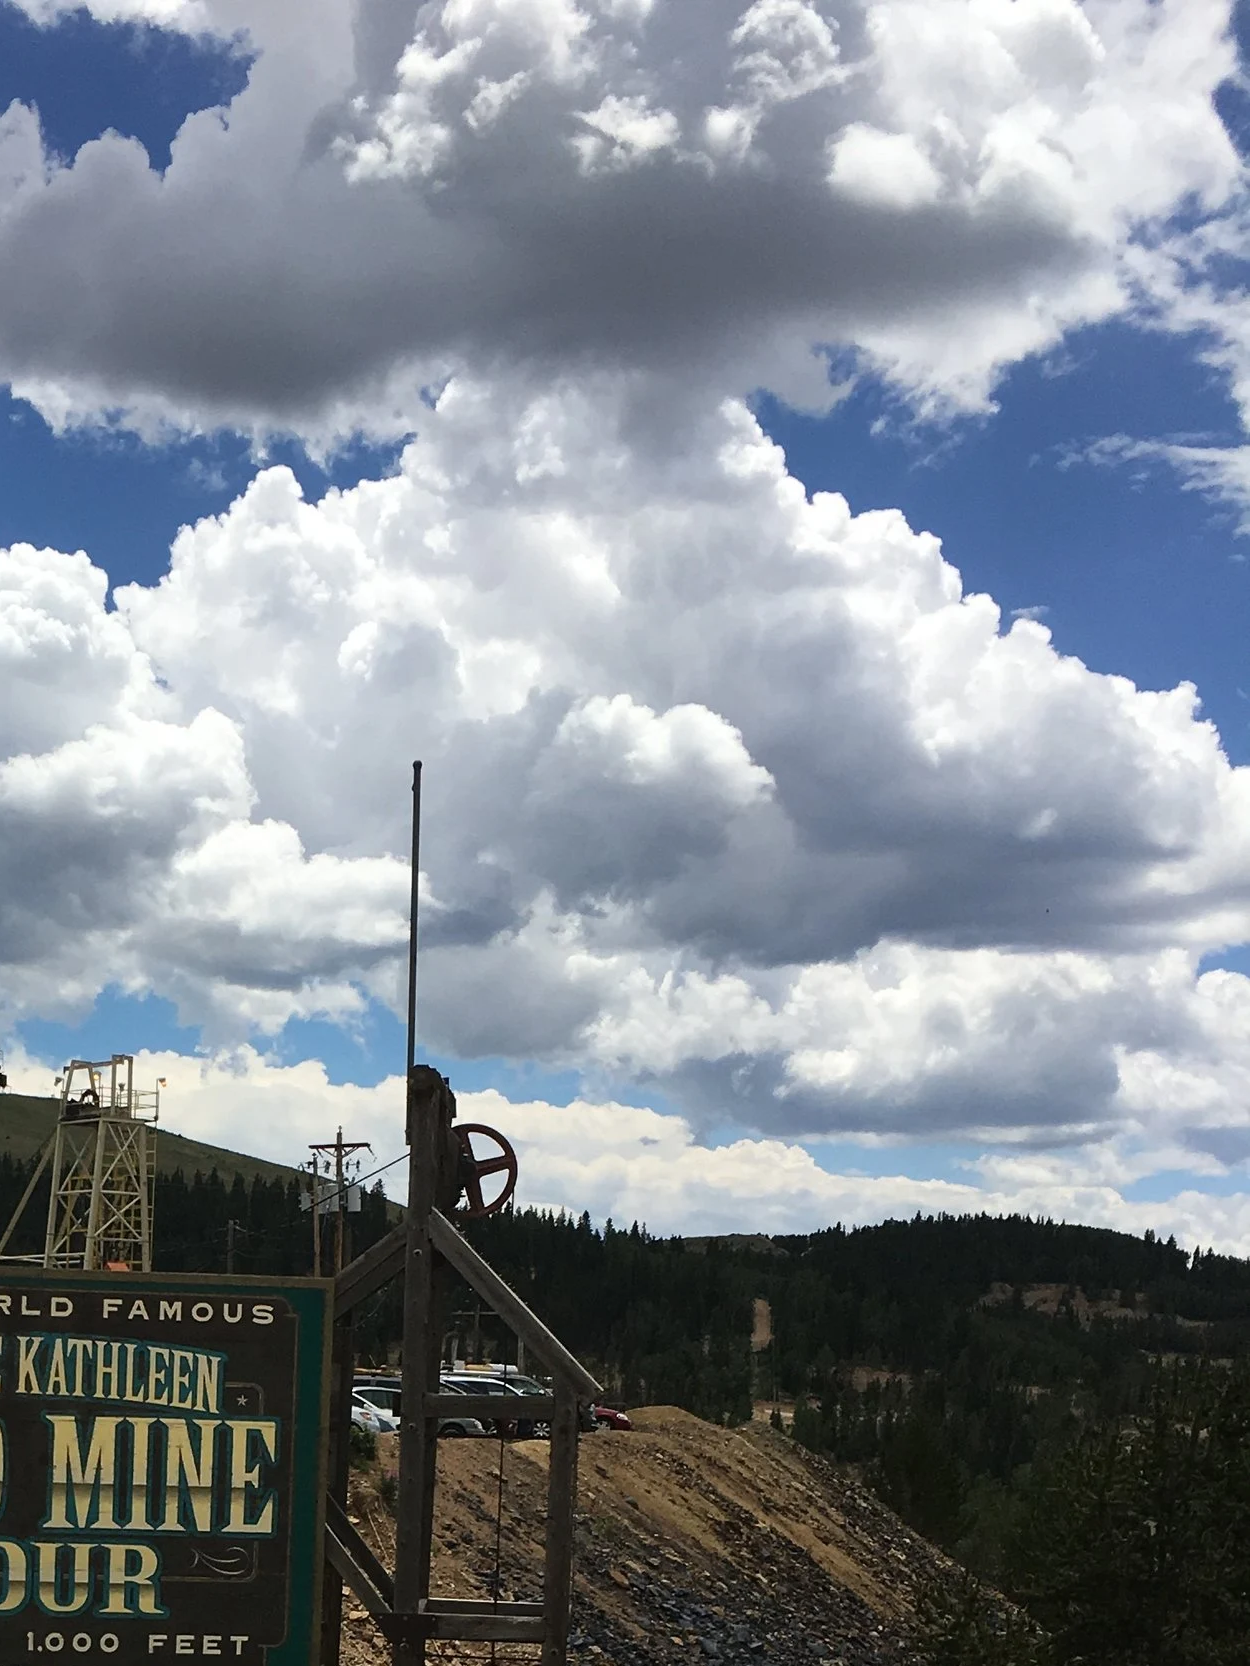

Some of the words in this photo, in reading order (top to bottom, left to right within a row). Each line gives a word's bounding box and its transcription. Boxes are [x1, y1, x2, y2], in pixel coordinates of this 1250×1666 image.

[102, 1298, 275, 1325] FAMOUS
[15, 1336, 222, 1414] KATHLEEN
[42, 1415, 276, 1533] MINE
[148, 1634, 249, 1655] FEET
